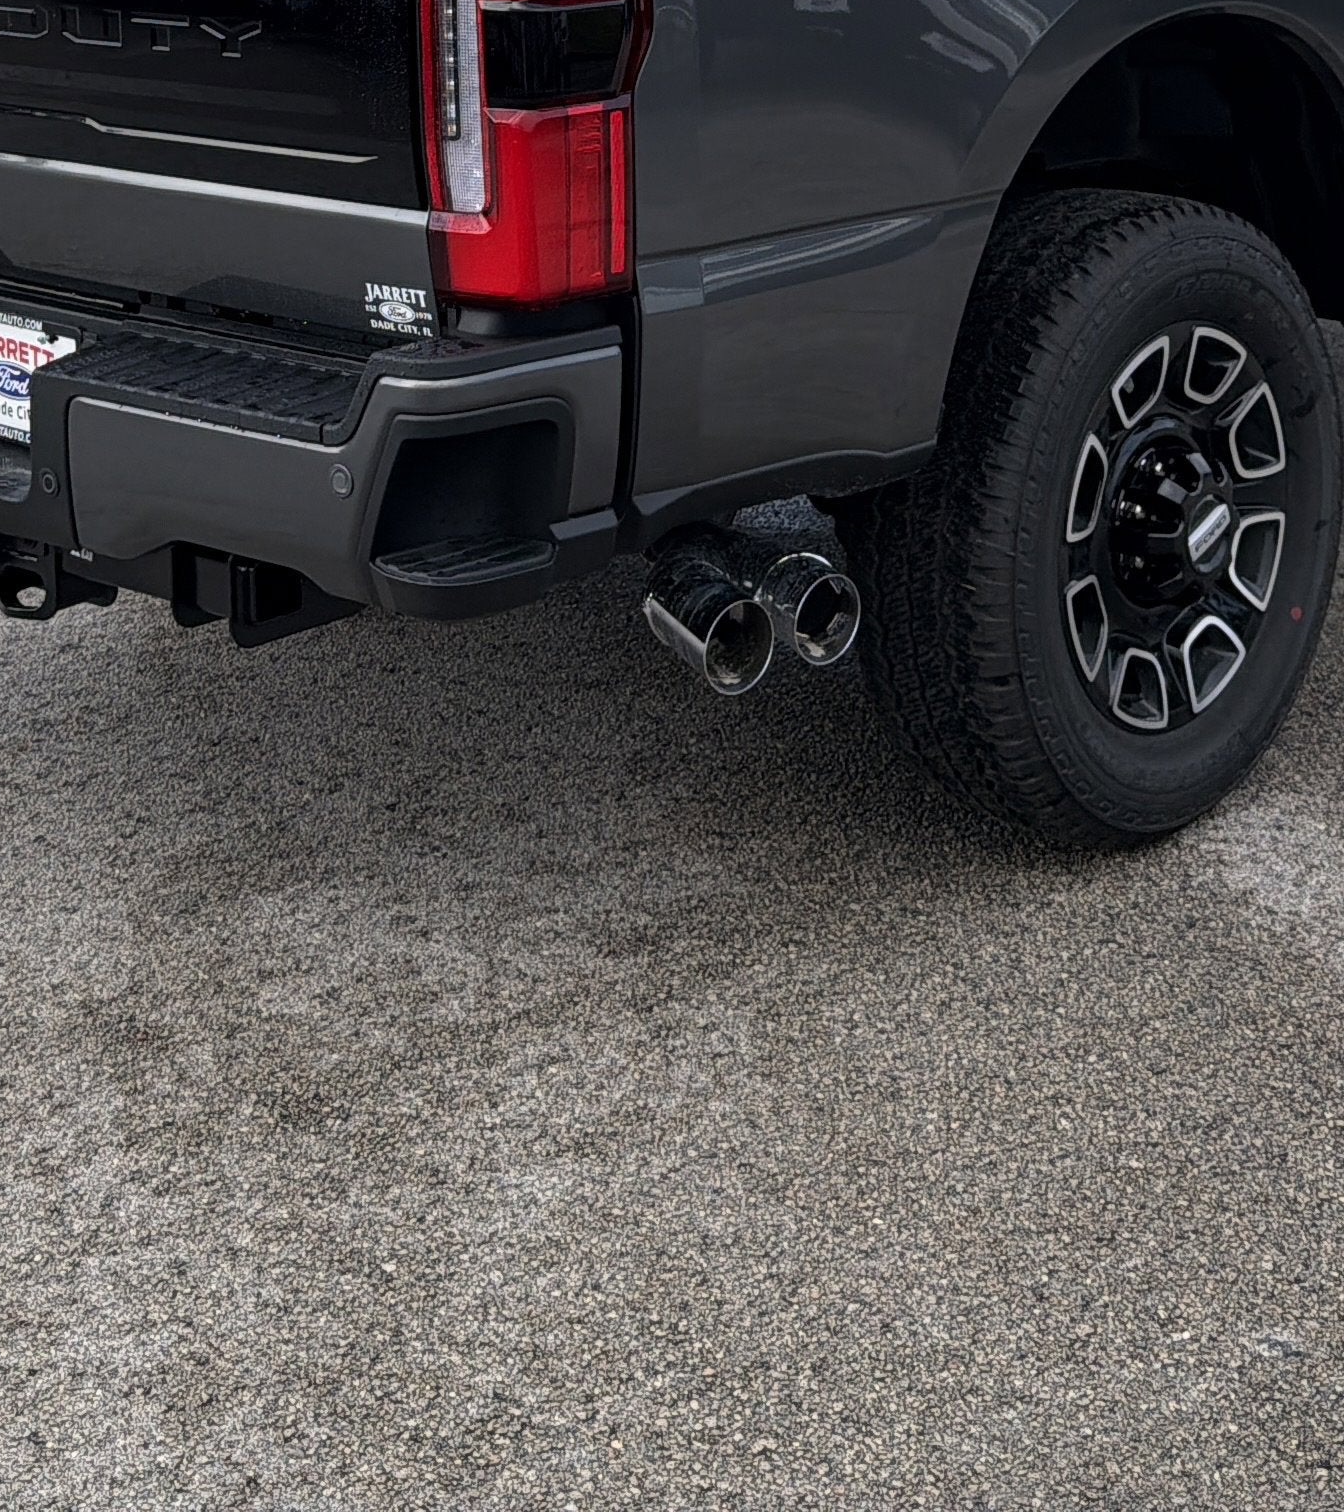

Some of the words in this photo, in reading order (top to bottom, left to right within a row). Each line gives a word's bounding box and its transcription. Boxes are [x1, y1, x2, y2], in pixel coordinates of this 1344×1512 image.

[364, 282, 427, 308] JARRETT
[370, 319, 397, 331] DADE
[398, 323, 421, 336] CITY,
[422, 326, 434, 338] FL
[16, 405, 31, 420] Ci
[1194, 514, 1227, 553] FORD
